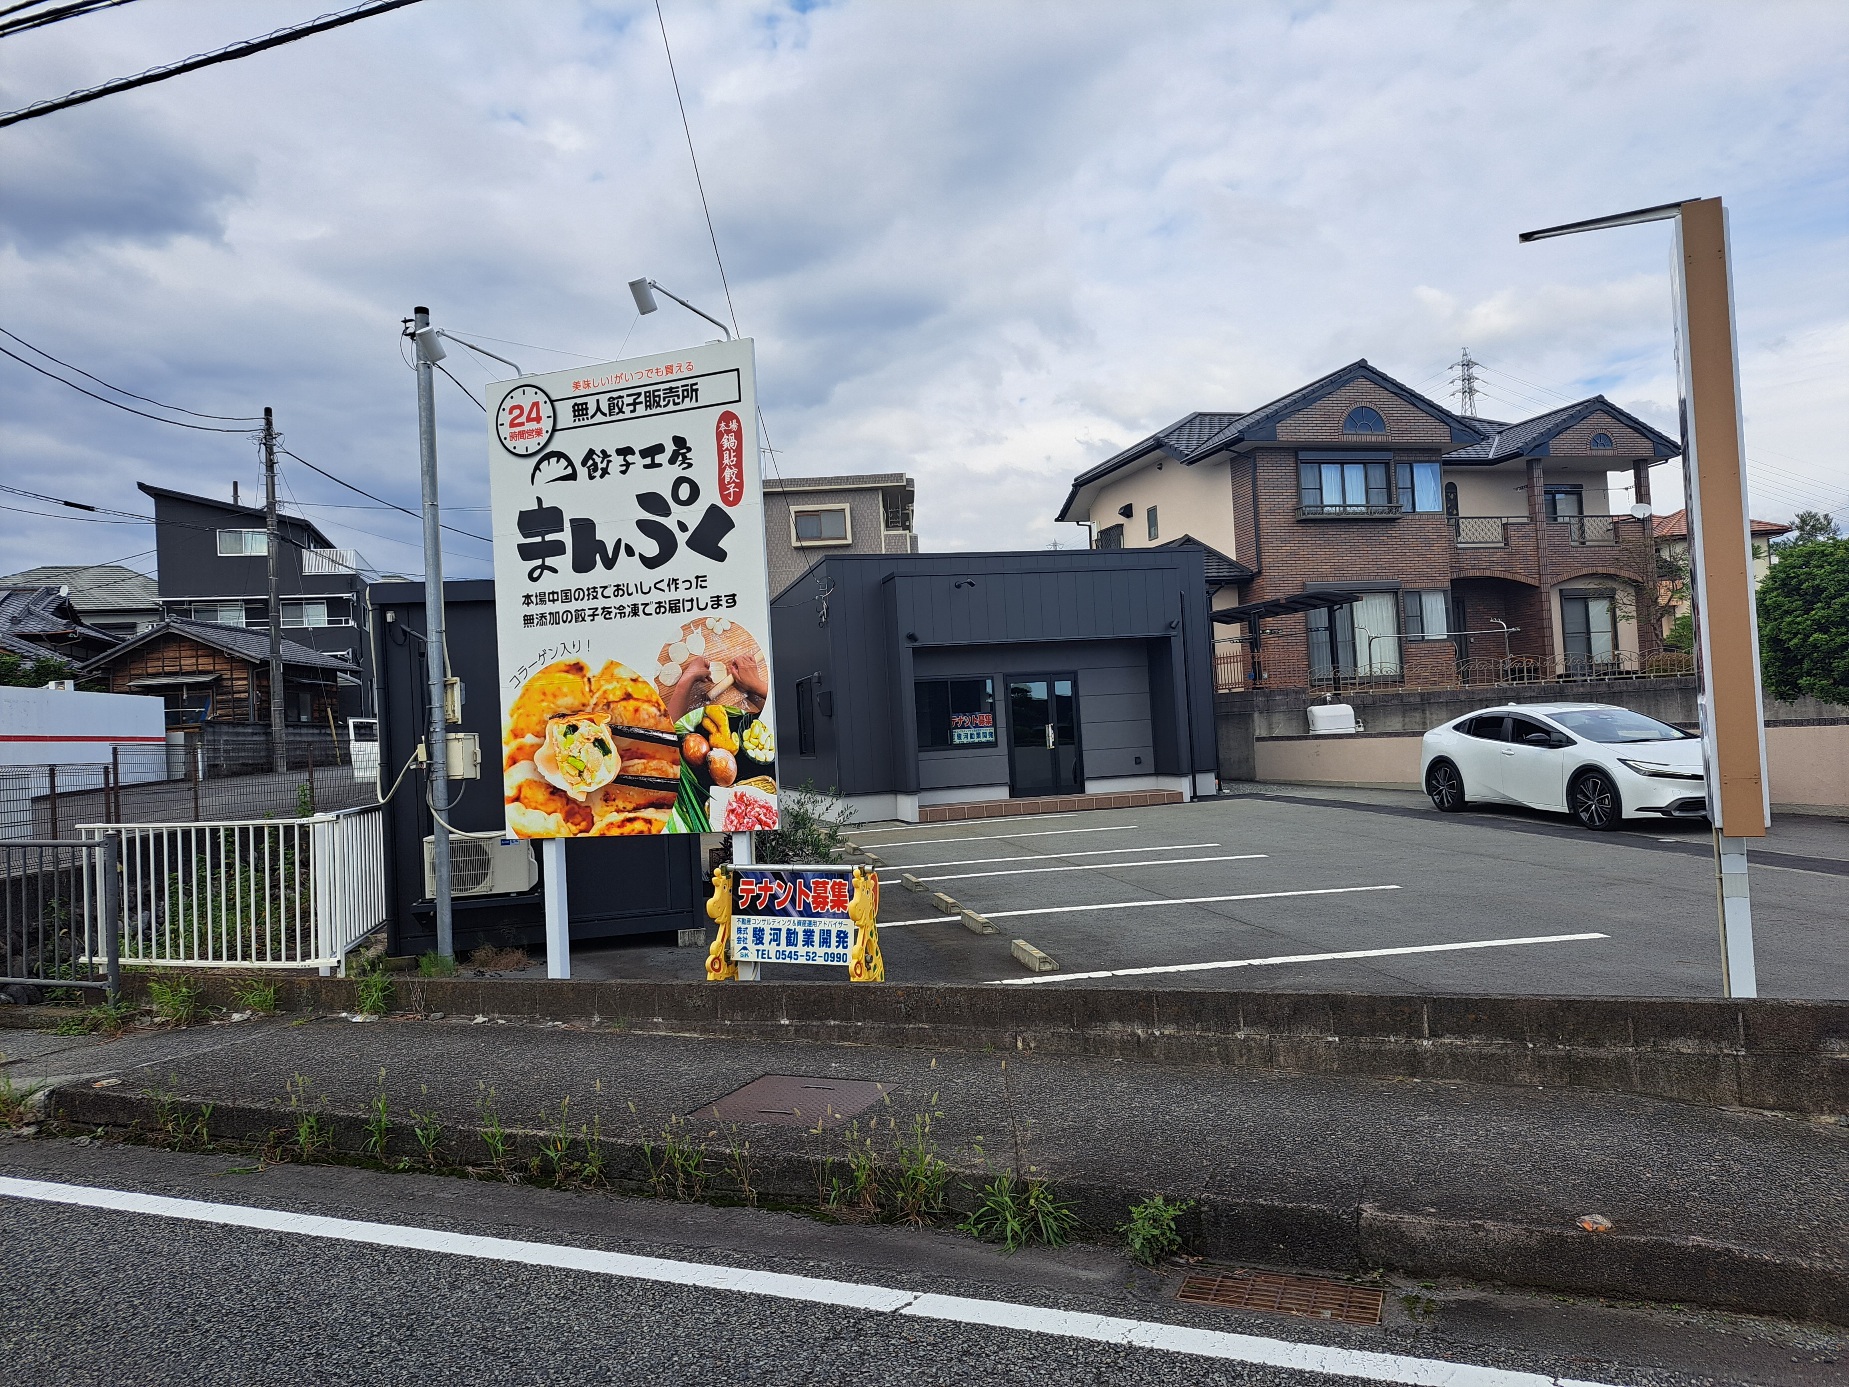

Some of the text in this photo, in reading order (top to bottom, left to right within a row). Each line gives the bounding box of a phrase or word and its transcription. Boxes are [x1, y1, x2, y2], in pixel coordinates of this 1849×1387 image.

[572, 361, 694, 392] 美味しい!がいつでも買える
[507, 400, 543, 429] 24
[571, 382, 700, 423] 無人餃子販売所
[508, 427, 544, 442] 時間営業
[717, 419, 739, 433] 本場
[581, 435, 694, 481] 餃子工房
[720, 433, 741, 501] 鍋貼餃子
[517, 476, 735, 582] まんぷく
[521, 574, 708, 608] 本場中国の技でおいしく作った
[522, 592, 738, 629] 無添加の餃子を冷凍でお届けします
[509, 639, 590, 689] コラーゲン入り!
[739, 879, 849, 912] テナント募集
[736, 927, 748, 935] 株式
[736, 936, 748, 945] 会社
[752, 926, 849, 949] 駿河勧業開発
[755, 949, 848, 963] TEL 0545-52-0990
